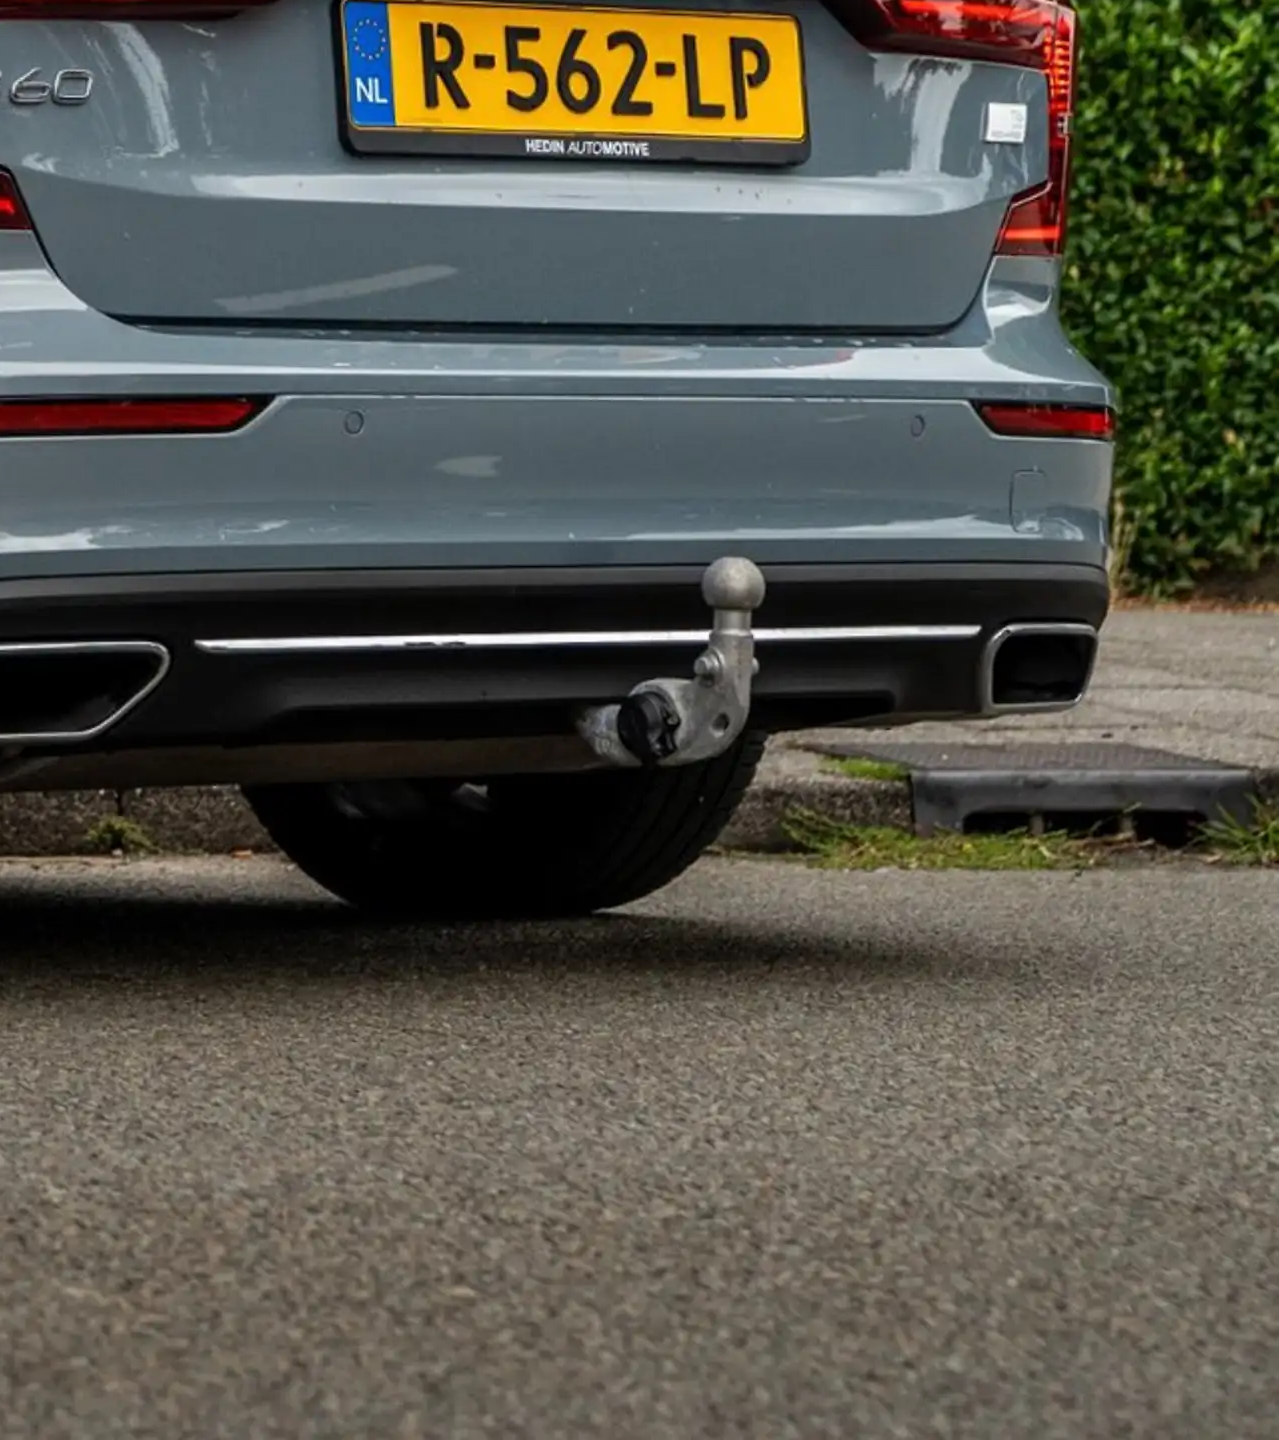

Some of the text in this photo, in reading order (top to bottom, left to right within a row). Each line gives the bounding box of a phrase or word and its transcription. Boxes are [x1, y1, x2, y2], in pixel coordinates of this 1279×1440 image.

[418, 21, 772, 121] R-562-LP
[355, 77, 389, 105] NL
[524, 138, 651, 157] HEDIN AUTOMOTIVE
